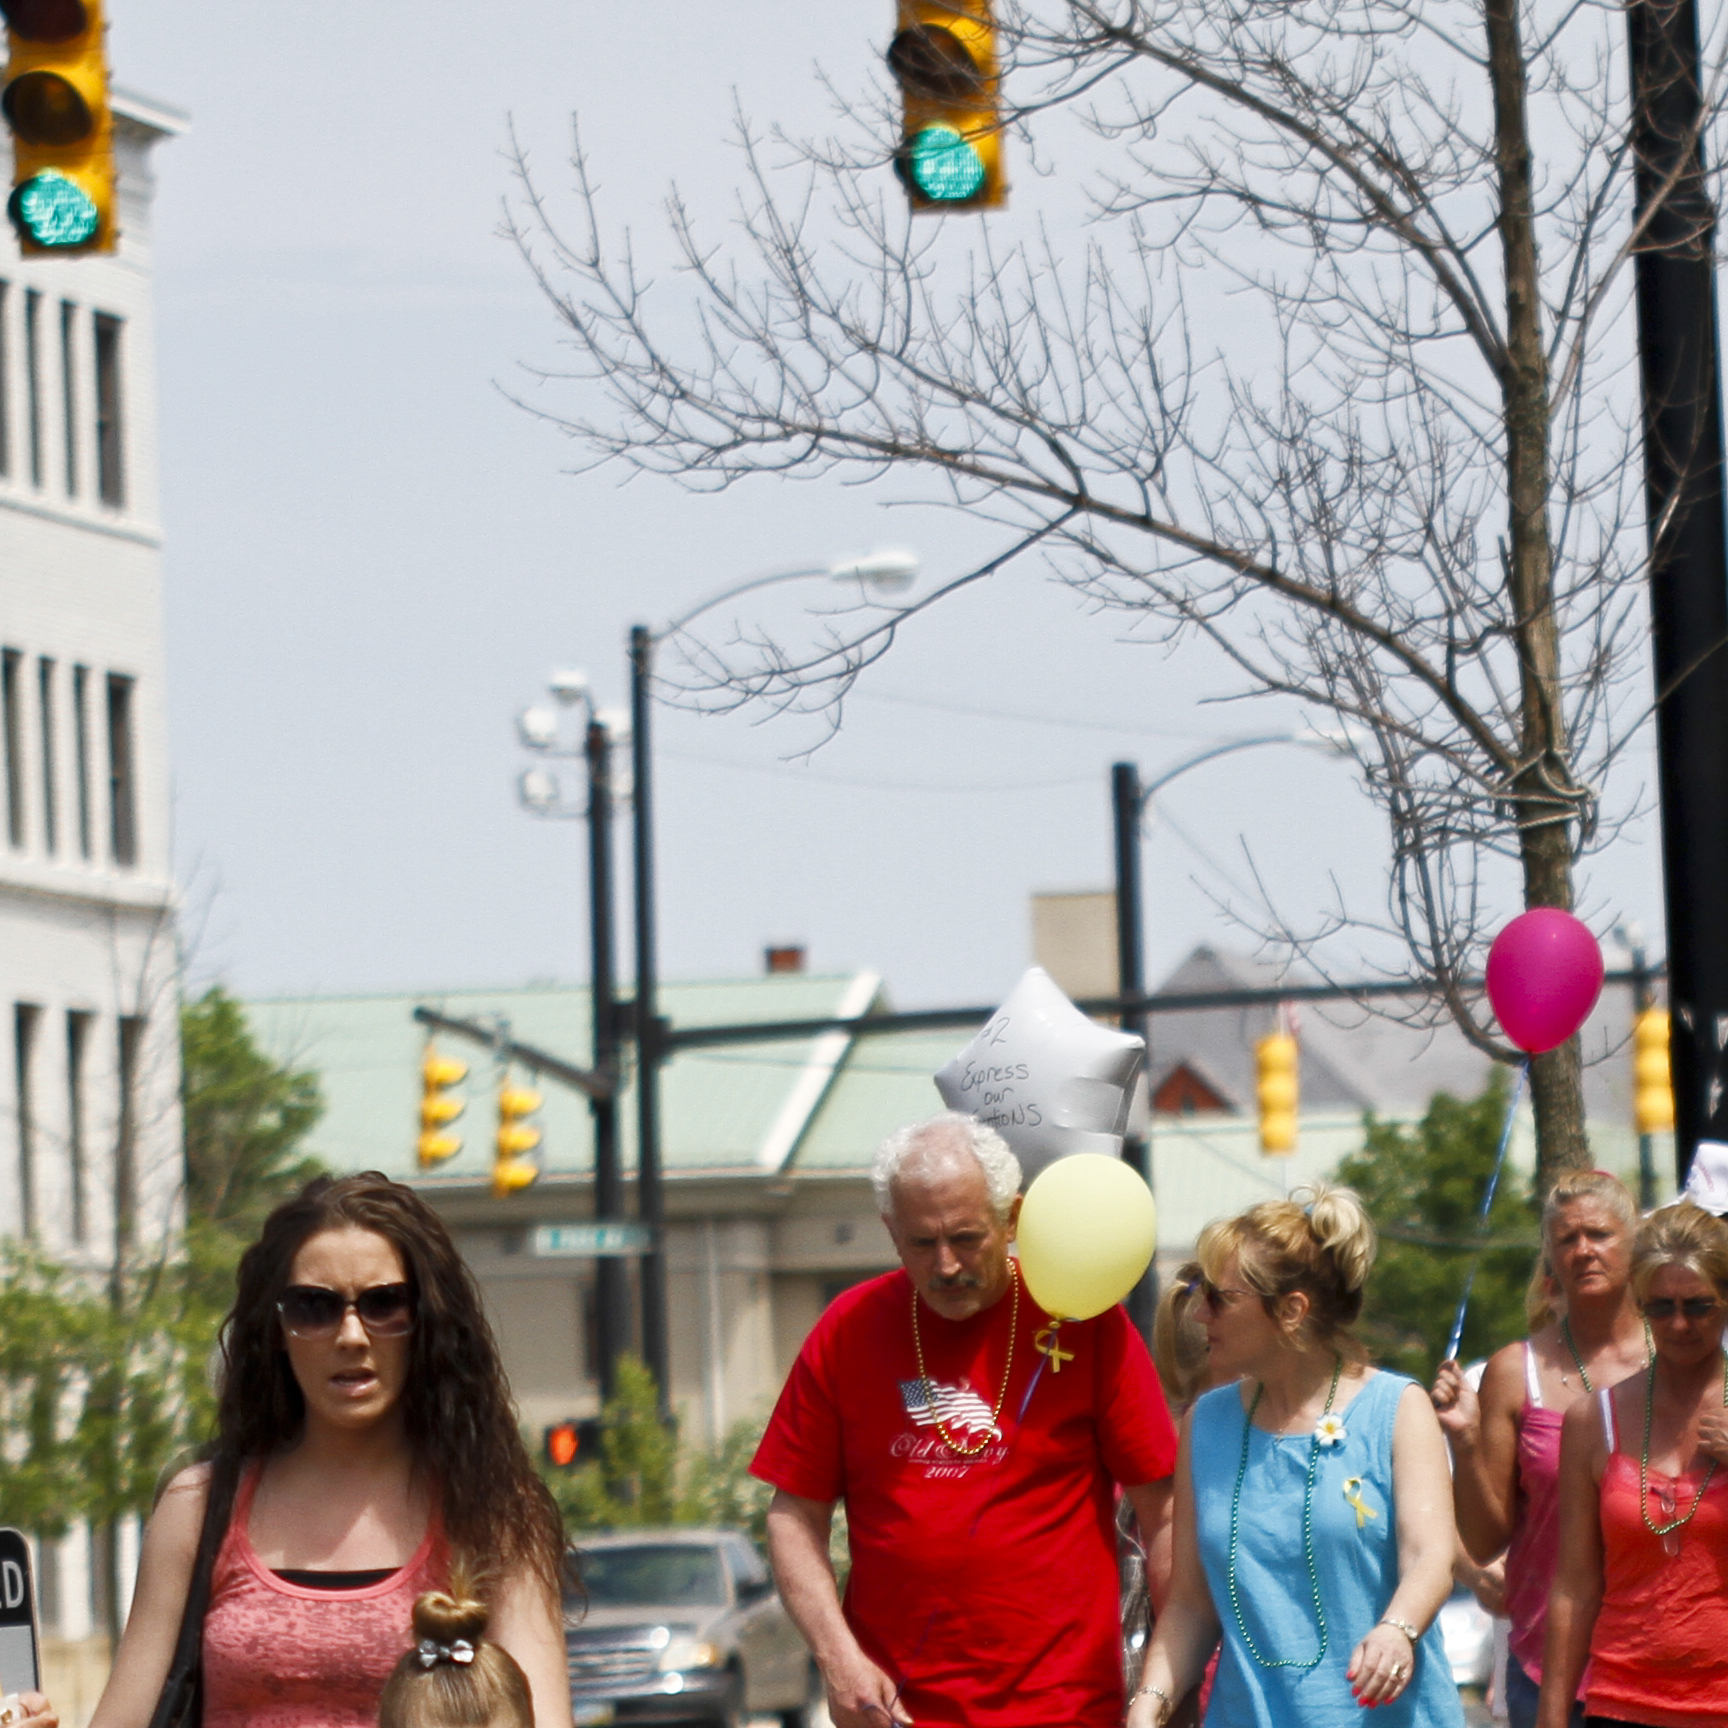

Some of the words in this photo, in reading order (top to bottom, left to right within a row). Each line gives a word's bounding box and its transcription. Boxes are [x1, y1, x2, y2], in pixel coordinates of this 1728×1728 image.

[960, 1061, 1030, 1093] Express
[983, 1087, 1014, 1105] our
[889, 1433, 935, 1458] Old
[924, 1465, 972, 1479] 2007
